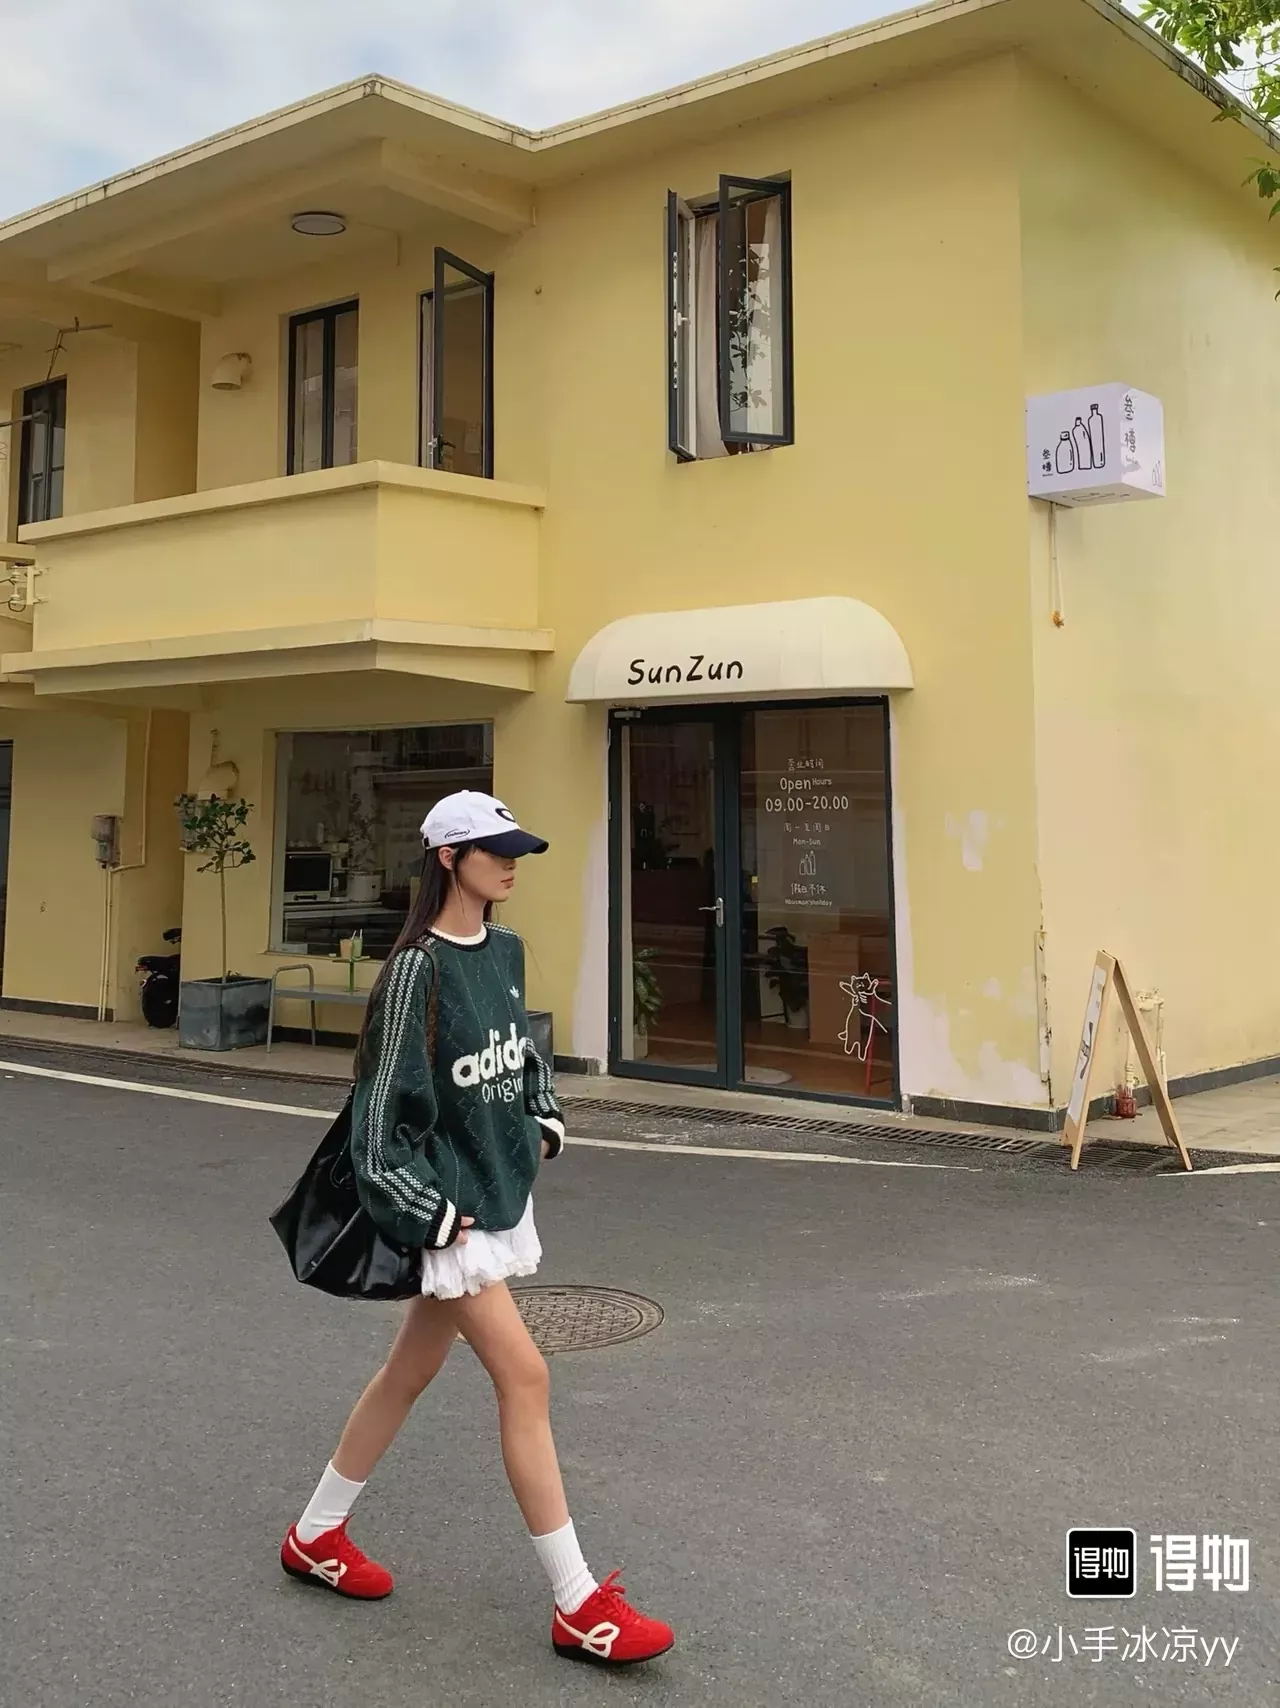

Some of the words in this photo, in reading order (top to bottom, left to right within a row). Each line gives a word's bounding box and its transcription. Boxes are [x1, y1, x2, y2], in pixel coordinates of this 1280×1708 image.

[627, 655, 743, 685] SunZun
[780, 777, 812, 794] Open
[812, 778, 832, 786] Hours
[765, 796, 849, 812] 09.00-20.00
[792, 837, 821, 846] Mon-Sun
